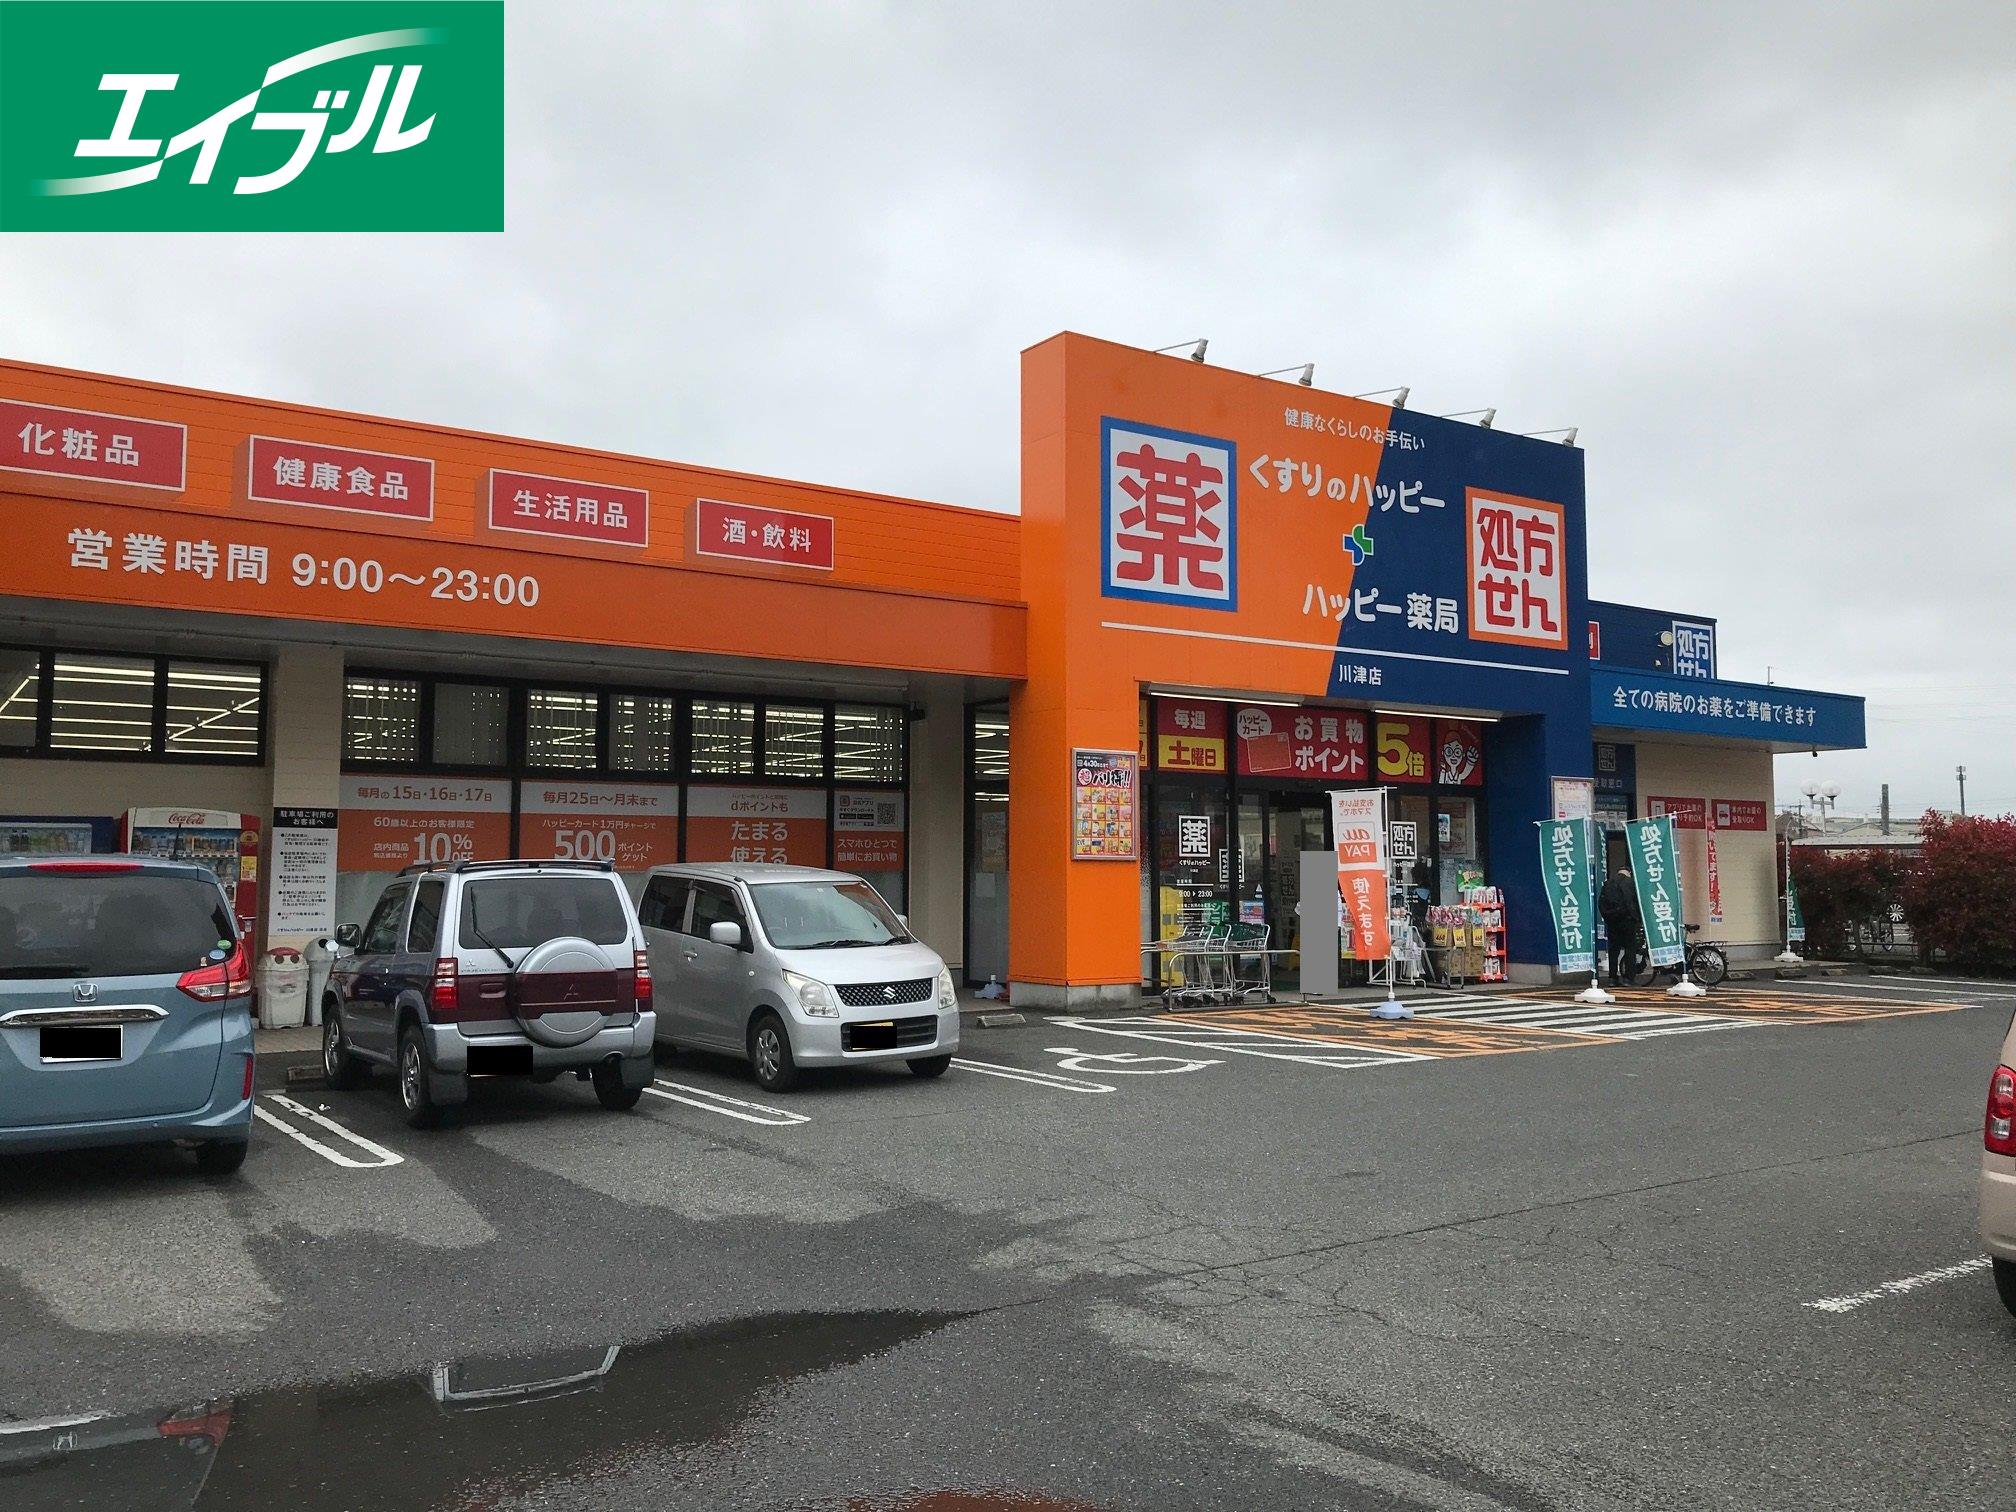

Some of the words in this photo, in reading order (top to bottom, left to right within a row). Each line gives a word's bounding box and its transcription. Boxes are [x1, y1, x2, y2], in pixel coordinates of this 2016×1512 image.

[1284, 406, 1425, 451] 健康なくらしのお手伝い
[17, 421, 140, 467] 化粧品
[273, 456, 410, 501] 健康食品
[1249, 453, 1446, 514] くすりのハッピー
[512, 489, 629, 529] 生活用品
[1116, 443, 1224, 592] 薬
[722, 516, 812, 553] 酒・飲料
[67, 528, 269, 585] 営業時間
[1302, 584, 1459, 635] ハッピー薬局
[1338, 663, 1382, 686] 川津店
[1174, 708, 1206, 730] 毎週
[1239, 714, 1268, 724] ハッピー
[1613, 686, 1817, 727] 全ての病院のお薬をご準備できます
[1242, 725, 1265, 735] カード
[1294, 715, 1364, 744] お買物
[1167, 739, 1217, 767] 土曜日
[1294, 745, 1364, 774] ポイント
[730, 801, 789, 812] dポイントも
[554, 829, 616, 860] 500
[730, 821, 789, 840] たまる
[837, 839, 898, 848] スマホひとつで
[1182, 820, 1208, 853] 薬
[617, 842, 653, 852] ポイント
[621, 852, 648, 862] ゲット
[730, 844, 788, 864] 使える
[837, 852, 898, 862] 簡単にお買い物
[1198, 890, 1213, 898] 23:00
